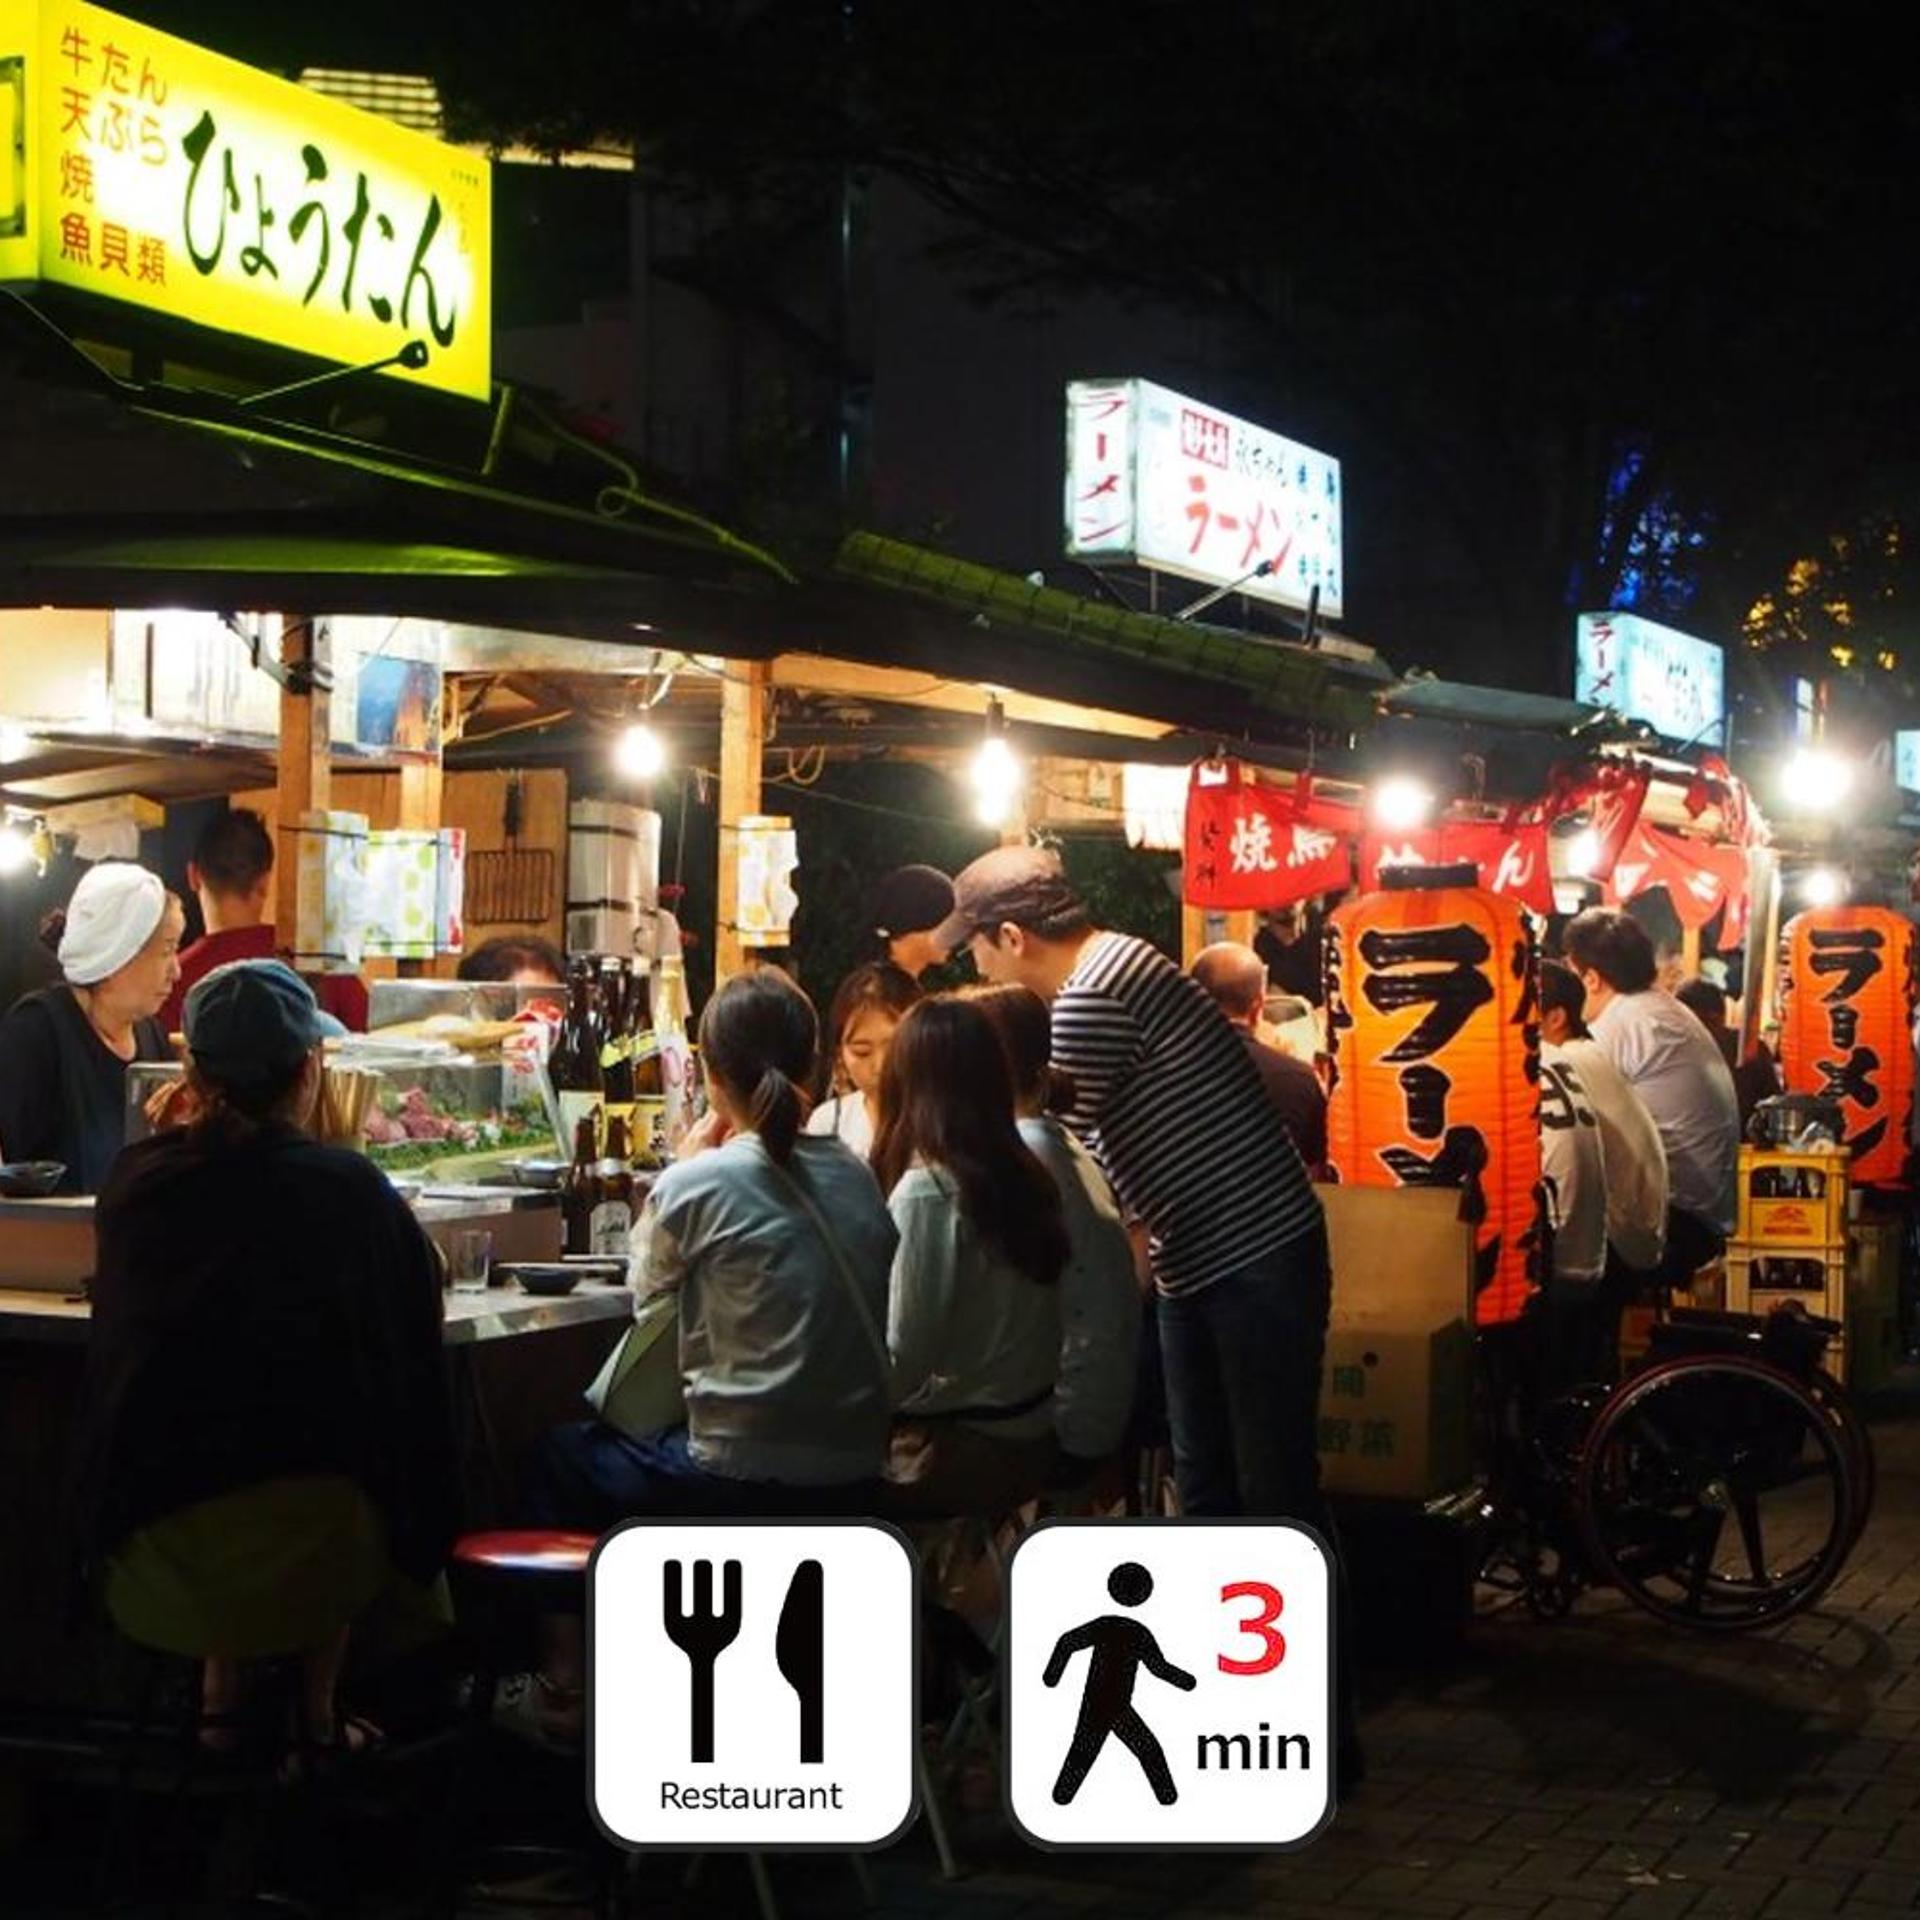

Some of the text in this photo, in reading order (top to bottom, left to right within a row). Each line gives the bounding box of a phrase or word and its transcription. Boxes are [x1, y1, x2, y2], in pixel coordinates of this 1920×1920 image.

[60, 25, 168, 107] 牛たん
[60, 85, 168, 167] 天ぷら
[59, 211, 168, 288] 魚貝類
[181, 109, 457, 348] ひょうたん
[1070, 391, 1128, 544] ラーメン
[1185, 475, 1293, 577] ラーメン
